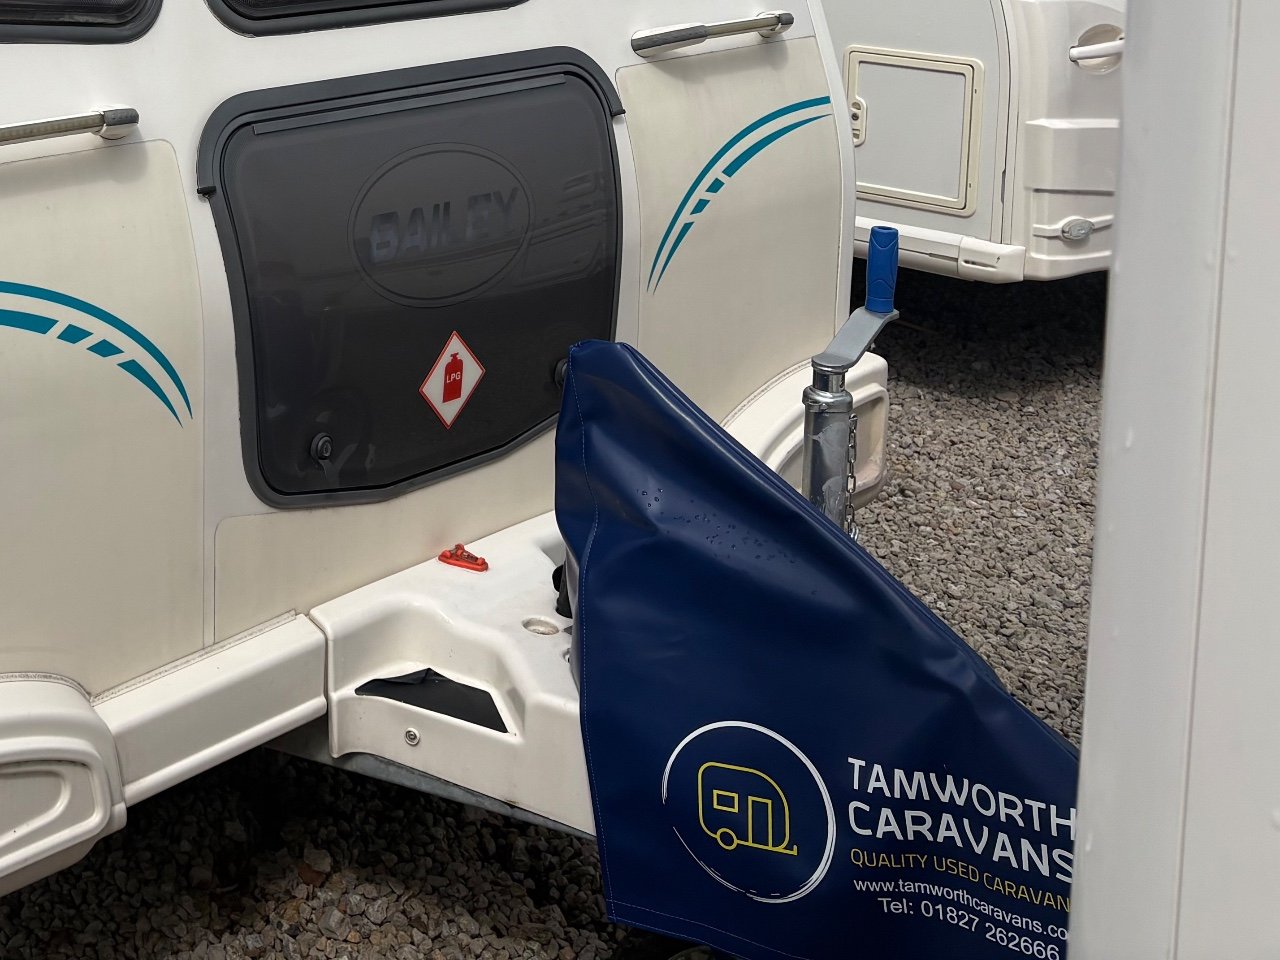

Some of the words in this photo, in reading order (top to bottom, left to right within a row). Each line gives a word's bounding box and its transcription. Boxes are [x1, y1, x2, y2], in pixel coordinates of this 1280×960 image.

[370, 187, 518, 266] BAILEY
[446, 371, 461, 384] LPG
[848, 757, 1077, 840] TAMWORTH
[848, 801, 1074, 884] CARAVANS
[850, 848, 928, 868] QUALITY
[933, 856, 980, 882] USED
[878, 897, 914, 915] Tel:
[921, 900, 980, 932] 01827
[985, 923, 1060, 960] 262666
